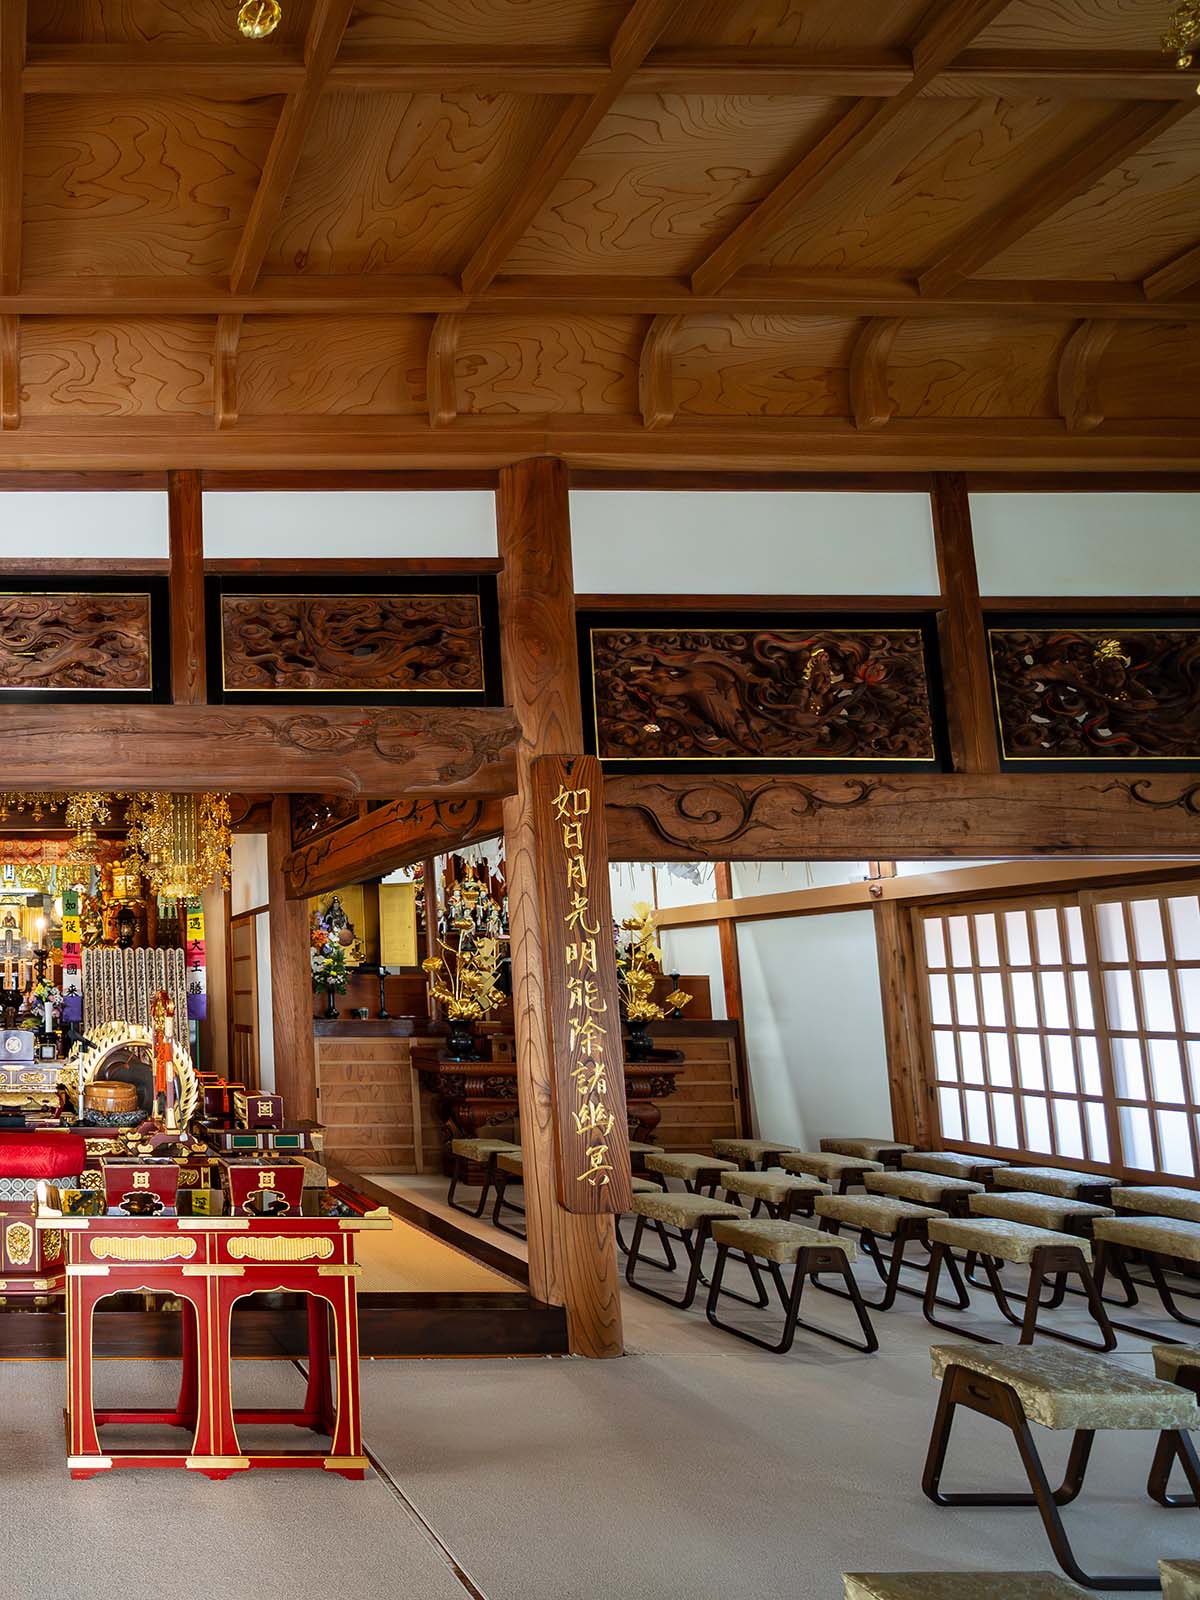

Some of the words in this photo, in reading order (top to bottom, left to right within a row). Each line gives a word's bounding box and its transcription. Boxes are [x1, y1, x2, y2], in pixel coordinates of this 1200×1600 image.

[551, 784, 615, 1187] 如日月光明能除諸幽冥
